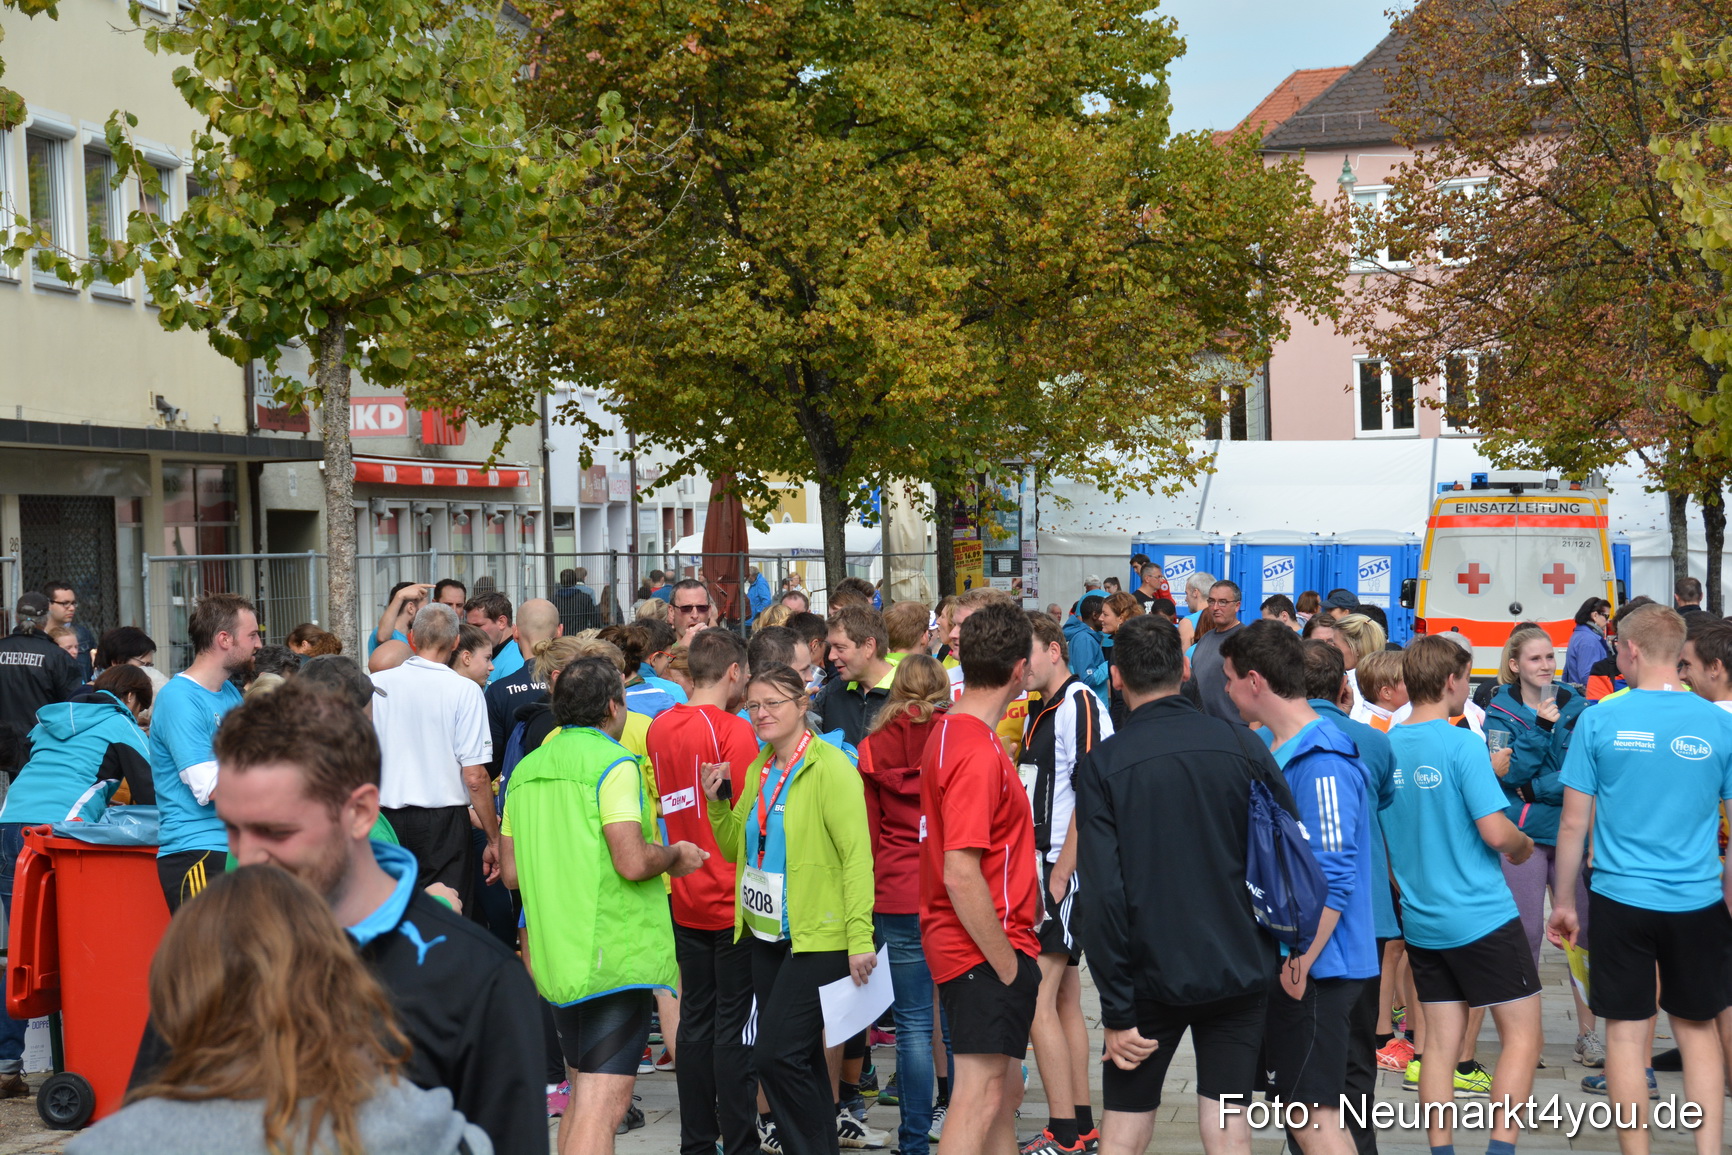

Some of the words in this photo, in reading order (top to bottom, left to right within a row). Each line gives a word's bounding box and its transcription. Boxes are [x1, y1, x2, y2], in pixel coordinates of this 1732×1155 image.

[1455, 503, 1581, 514] EINSATZLEITUNG
[9, 537, 19, 552] 26
[0, 652, 45, 667] CHERHEIT
[506, 683, 528, 695] The
[530, 682, 550, 690] wa
[1613, 740, 1656, 749] NeuerMarkt
[1675, 739, 1708, 755] Hervis
[743, 885, 773, 914] 5208
